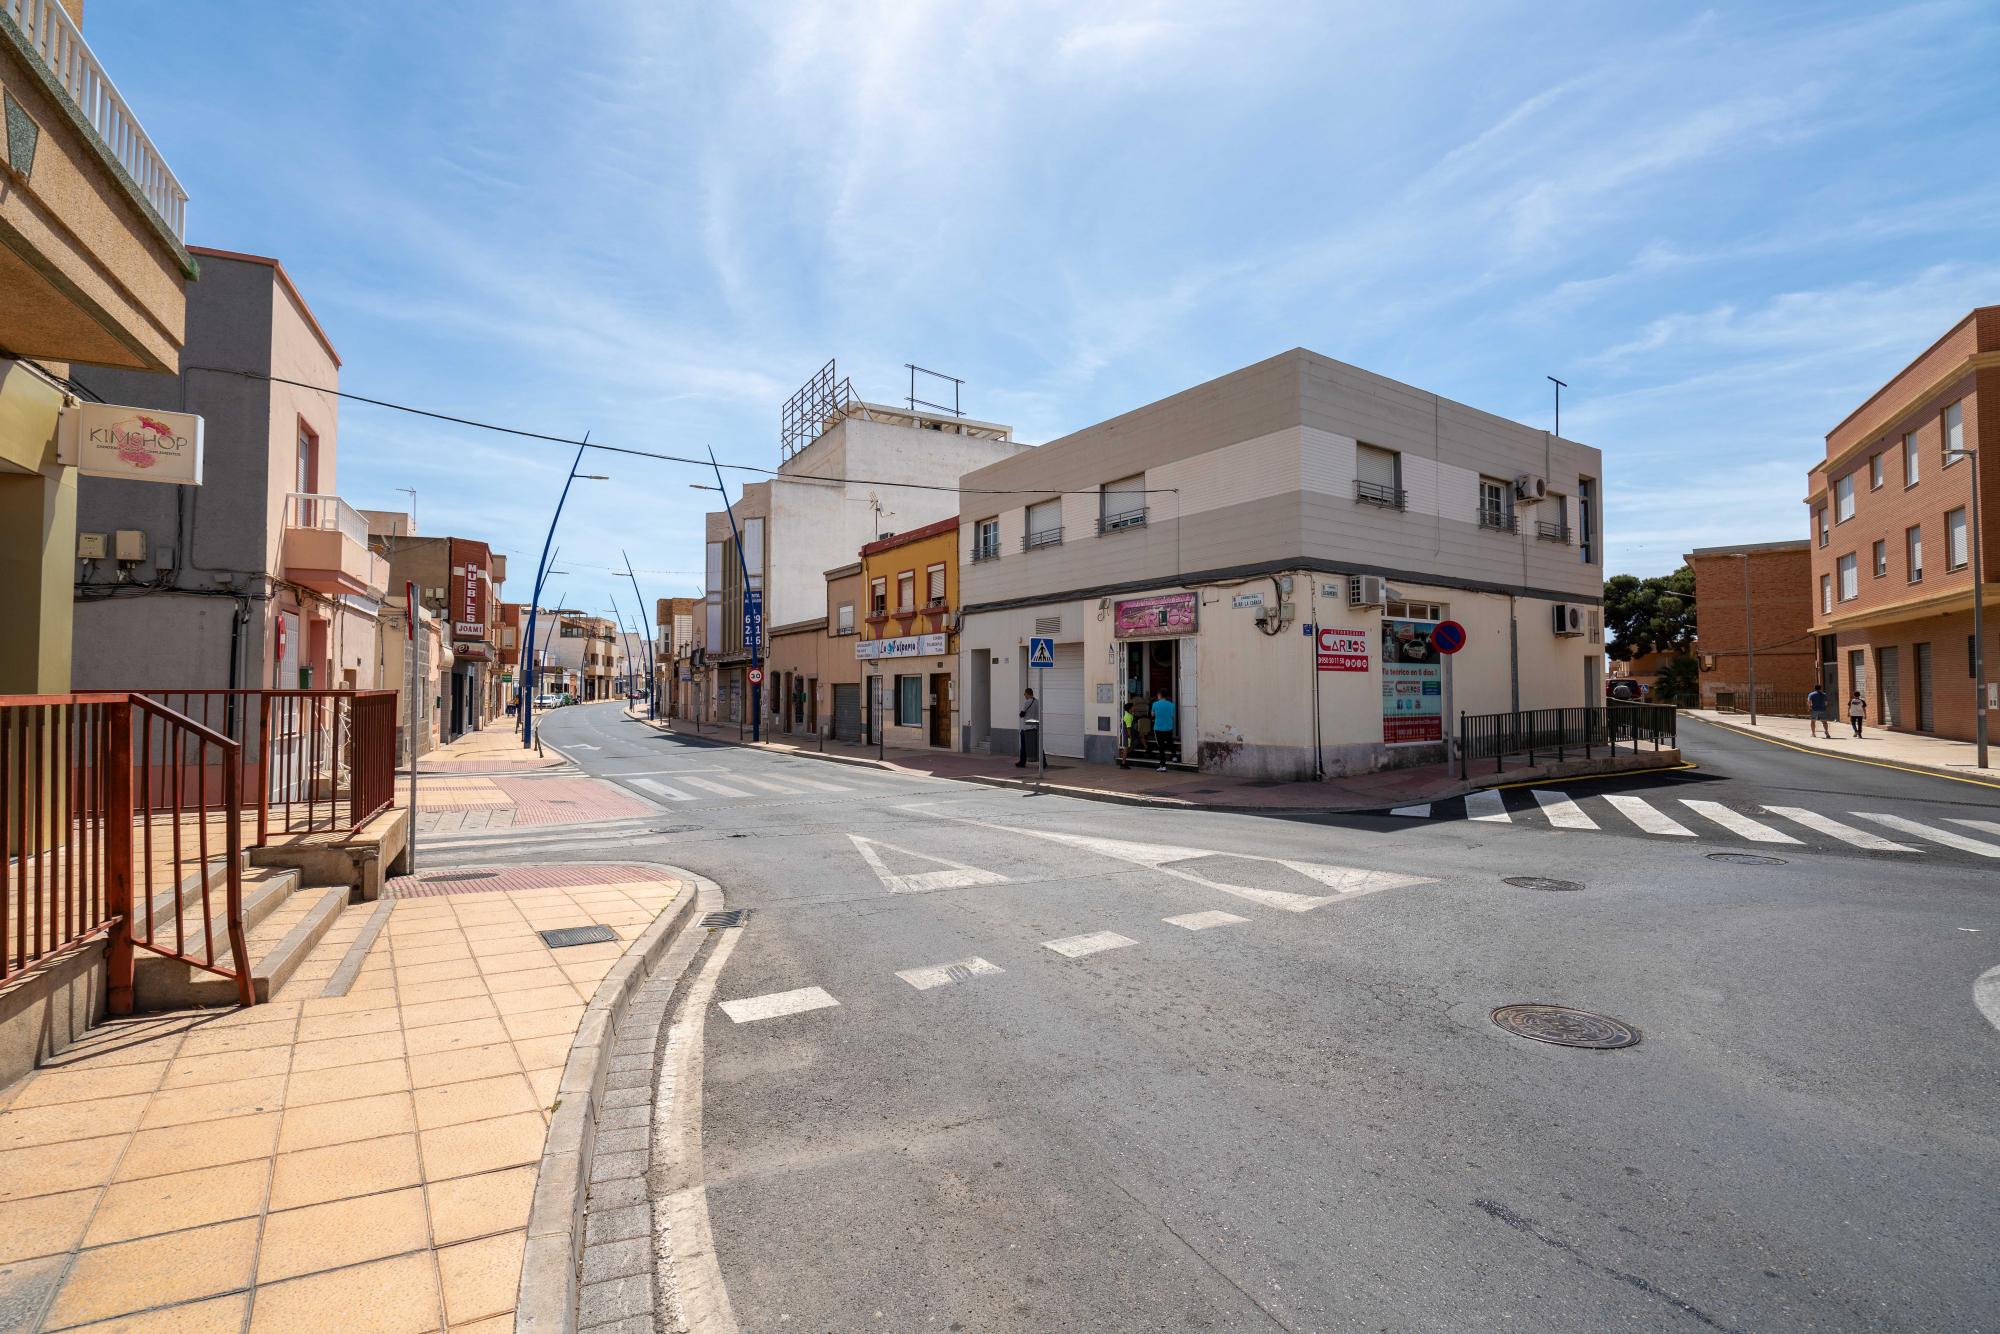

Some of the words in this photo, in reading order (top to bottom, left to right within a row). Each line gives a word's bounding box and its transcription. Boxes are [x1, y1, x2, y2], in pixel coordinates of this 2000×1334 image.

[90, 428, 188, 451] KIMSHOP
[467, 564, 477, 622] MUEBLES
[458, 625, 482, 633] JOAMI
[745, 625, 761, 634] 21
[1319, 629, 1366, 652] CARLOS
